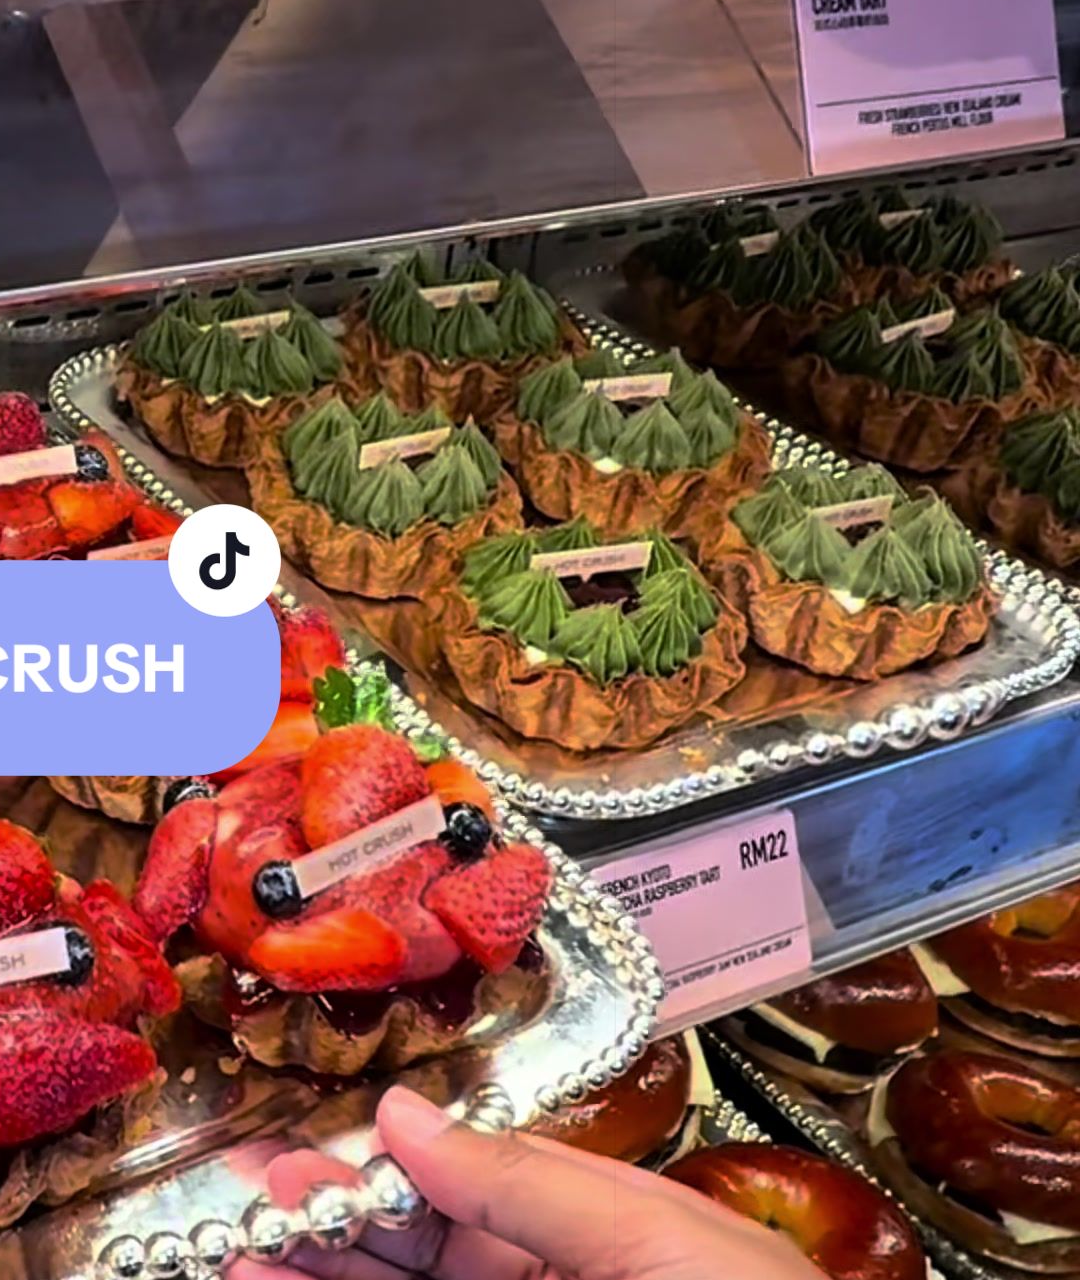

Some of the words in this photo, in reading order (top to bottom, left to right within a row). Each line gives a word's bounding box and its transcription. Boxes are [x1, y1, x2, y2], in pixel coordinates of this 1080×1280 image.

[328, 849, 359, 873] HOT
[363, 821, 414, 858] CRUSH
[739, 830, 788, 870] RM22
